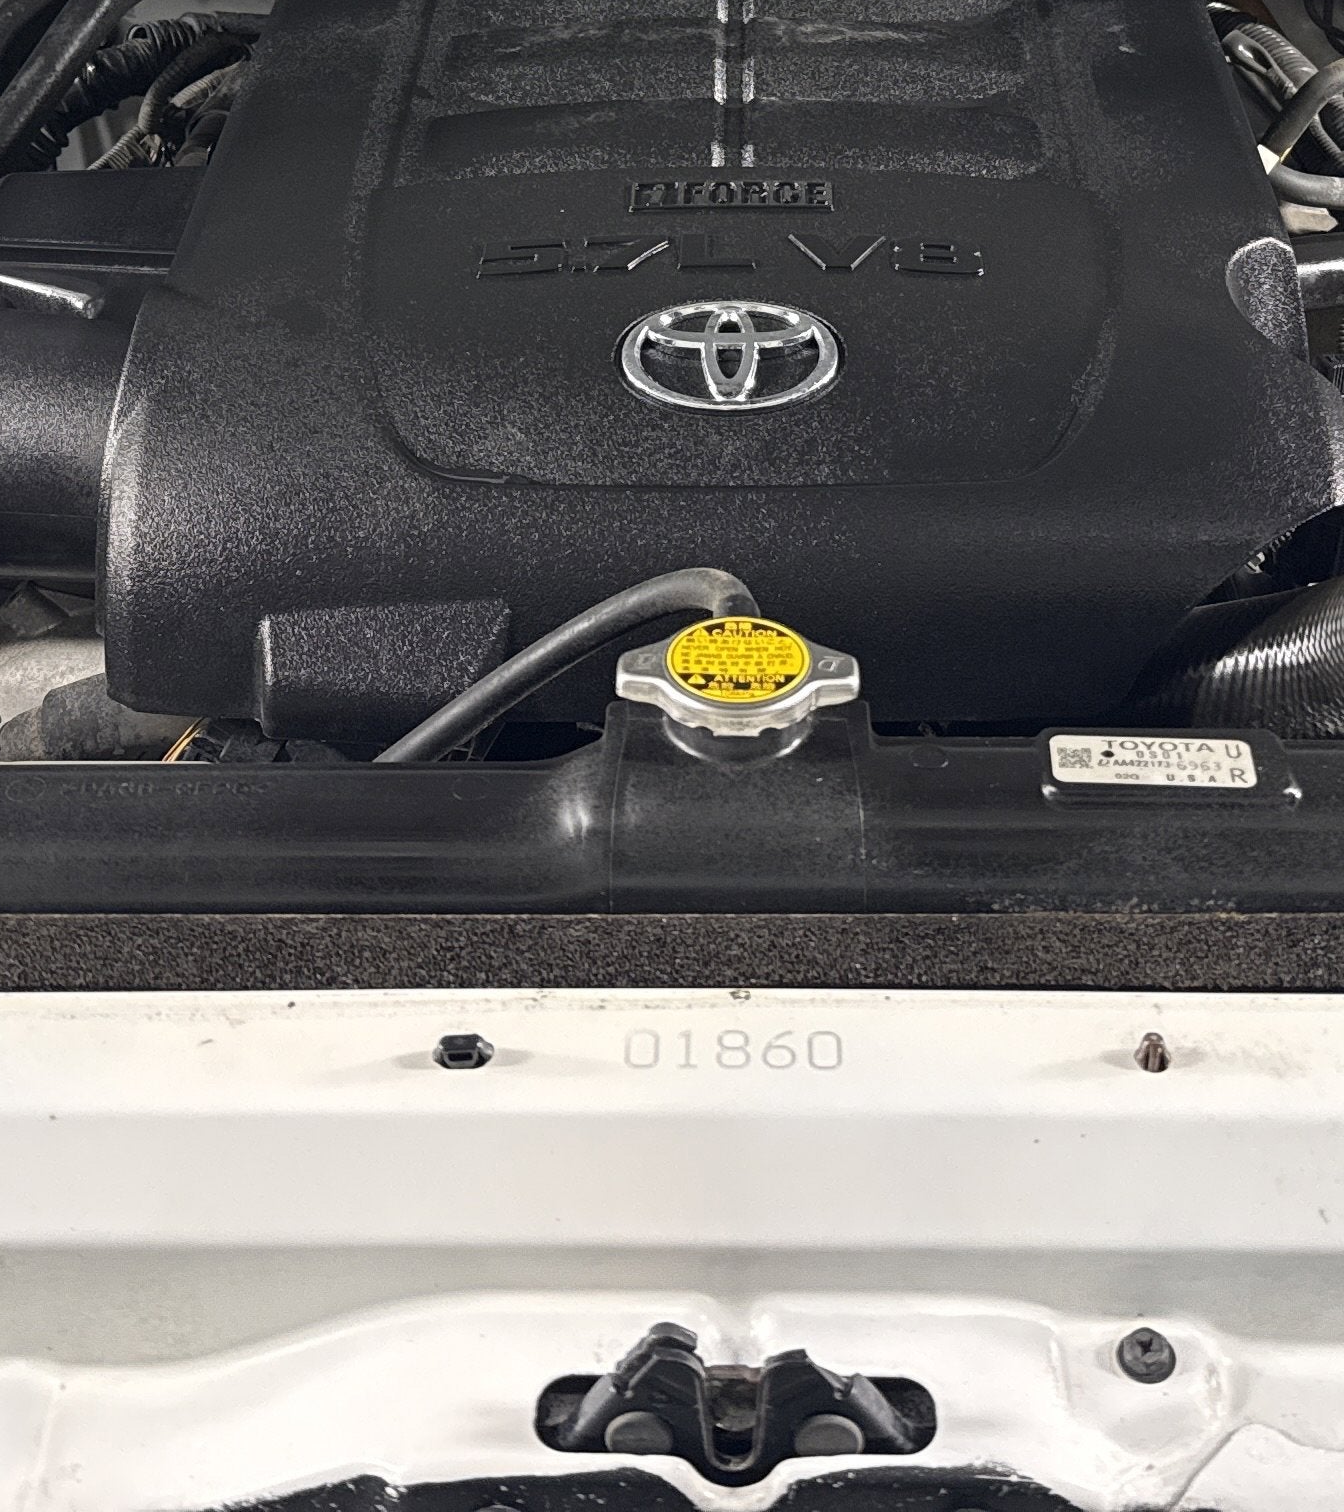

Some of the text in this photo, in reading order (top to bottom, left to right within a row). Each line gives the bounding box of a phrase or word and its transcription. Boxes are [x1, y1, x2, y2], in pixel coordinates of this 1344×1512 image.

[786, 233, 986, 278] V8
[711, 628, 778, 638] CAUTION
[713, 674, 786, 684] ATTENTION
[1101, 739, 1216, 753] TOYOTA
[623, 1028, 844, 1071] 01860
